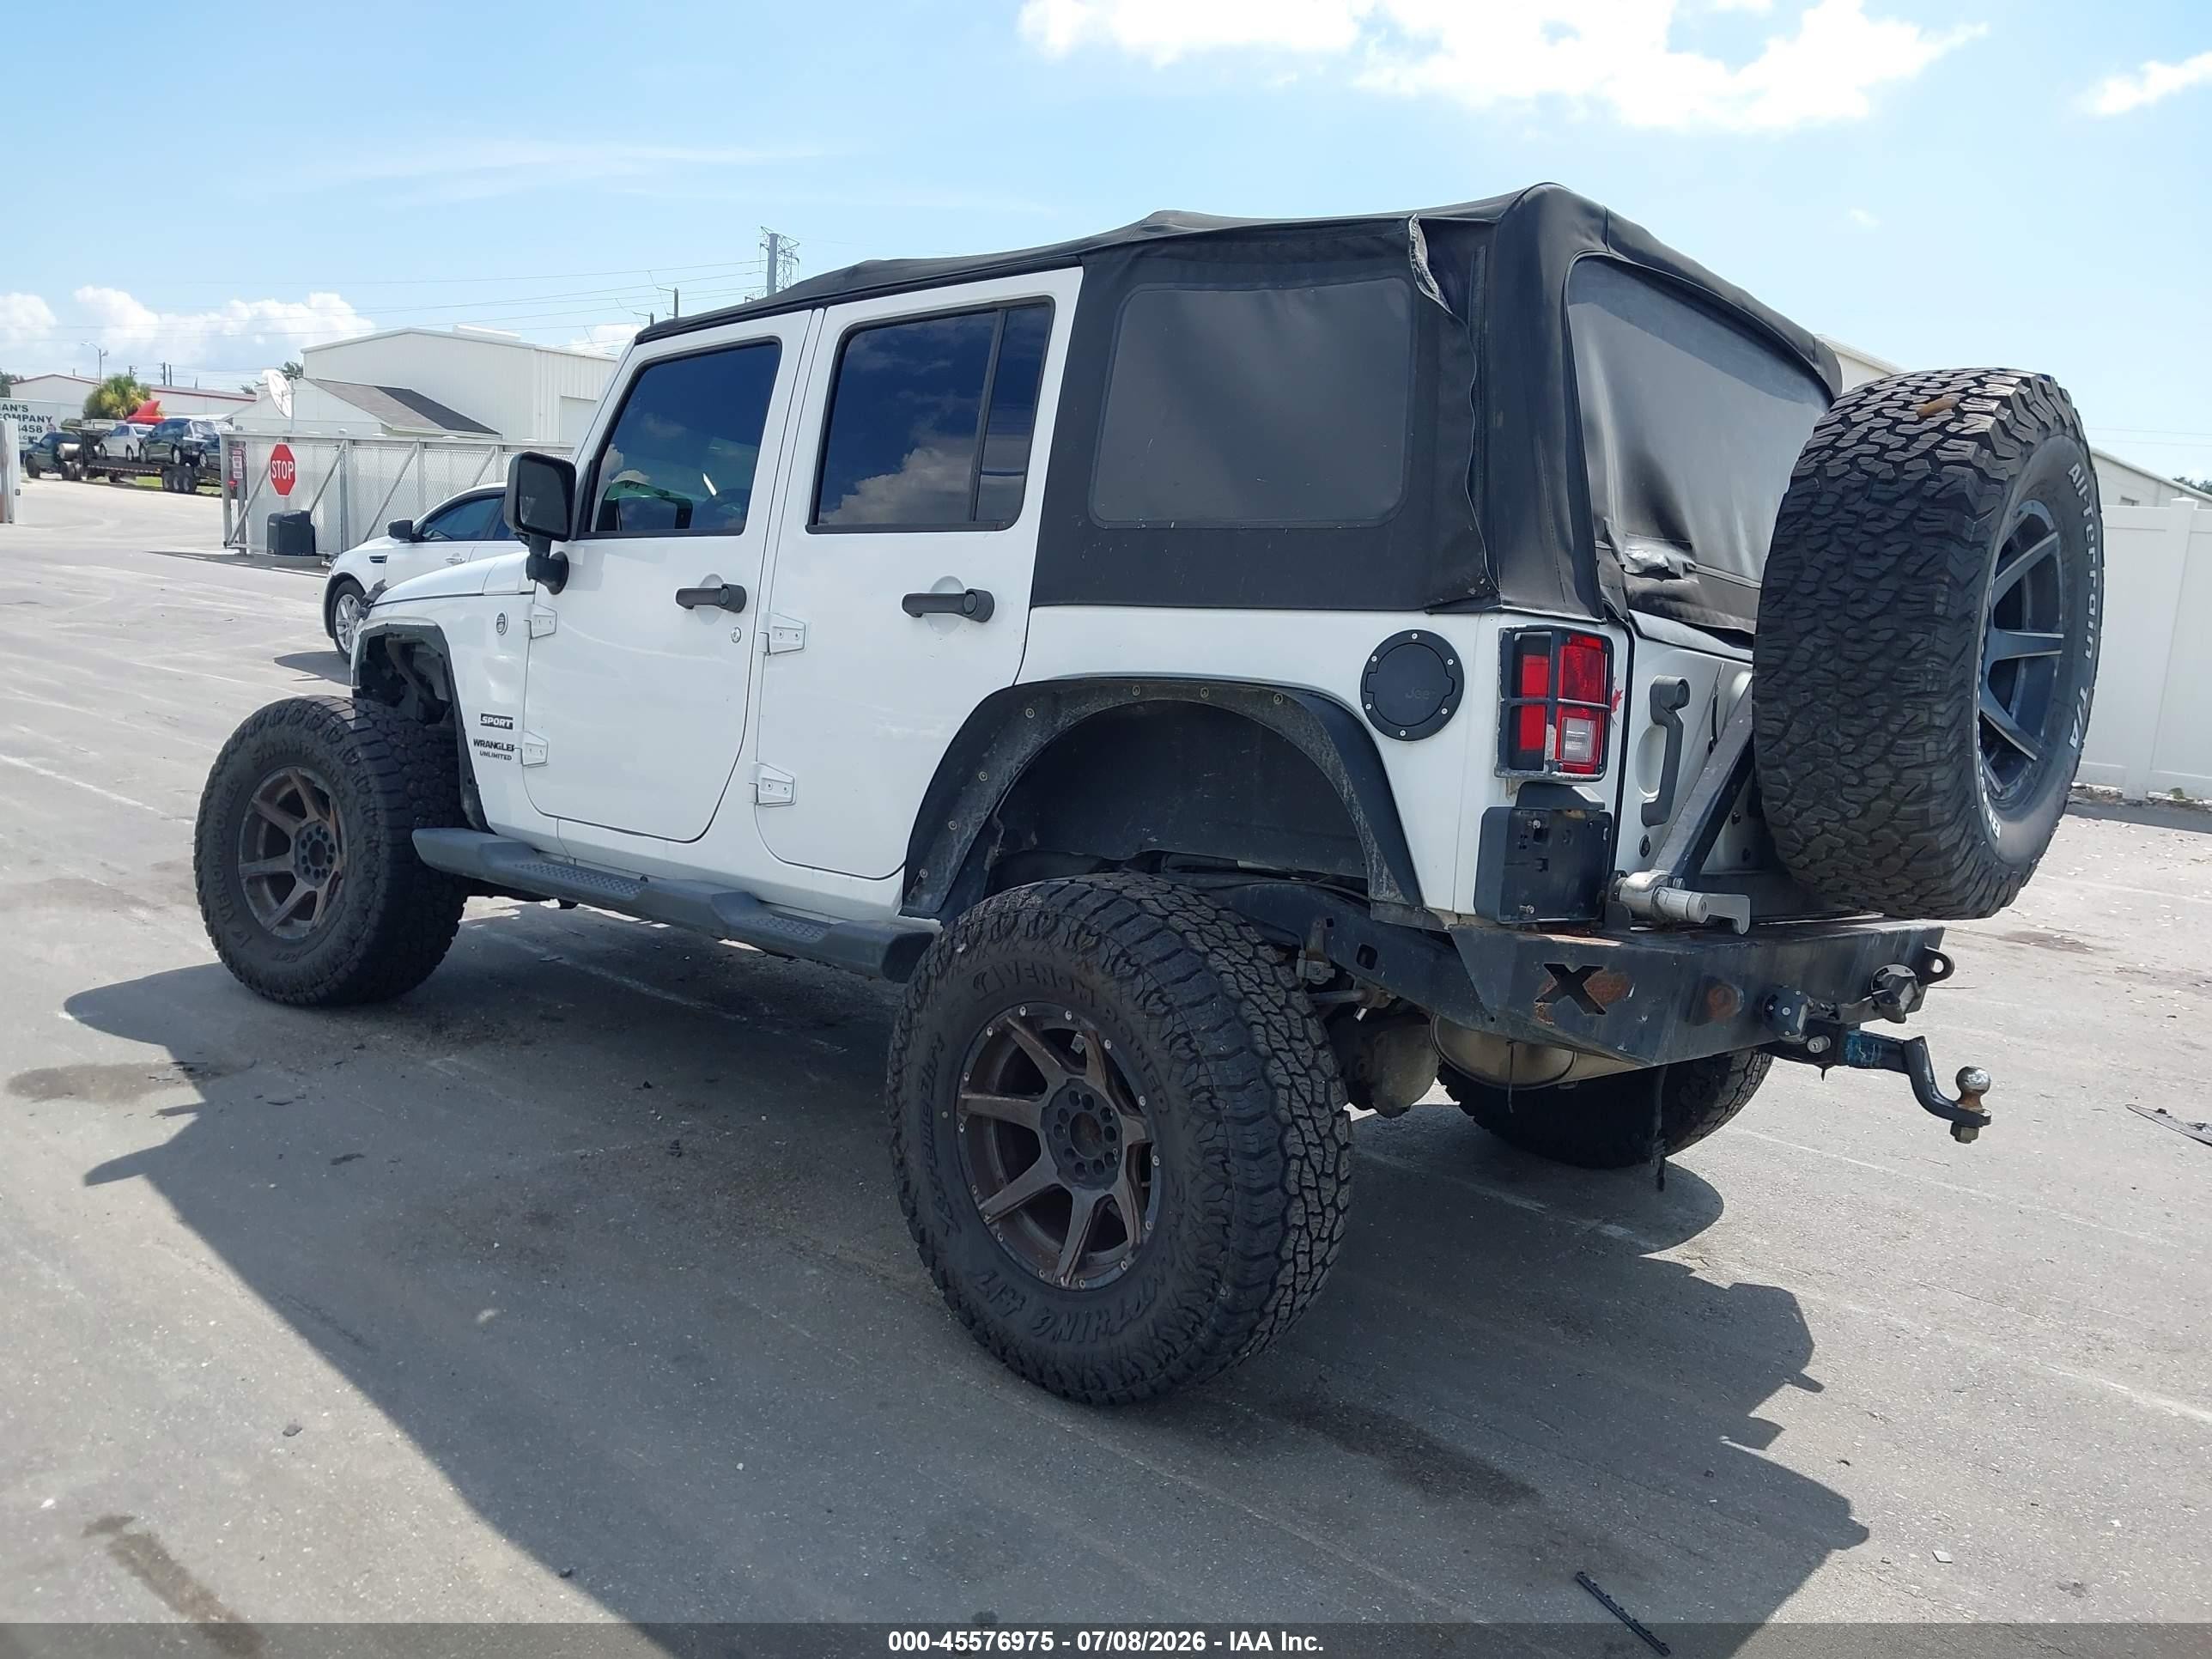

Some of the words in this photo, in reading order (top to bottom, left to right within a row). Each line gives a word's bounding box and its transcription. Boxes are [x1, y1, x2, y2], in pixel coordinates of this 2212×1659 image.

[0, 404, 28, 412] AN'S
[0, 413, 52, 423] OMPANY
[18, 424, 42, 434] 458
[271, 460, 295, 479] STOP
[2068, 463, 2097, 659] All-Terrain
[481, 714, 514, 729] SPORT
[2069, 687, 2090, 749] T/A
[479, 750, 513, 761] UNLIMITED
